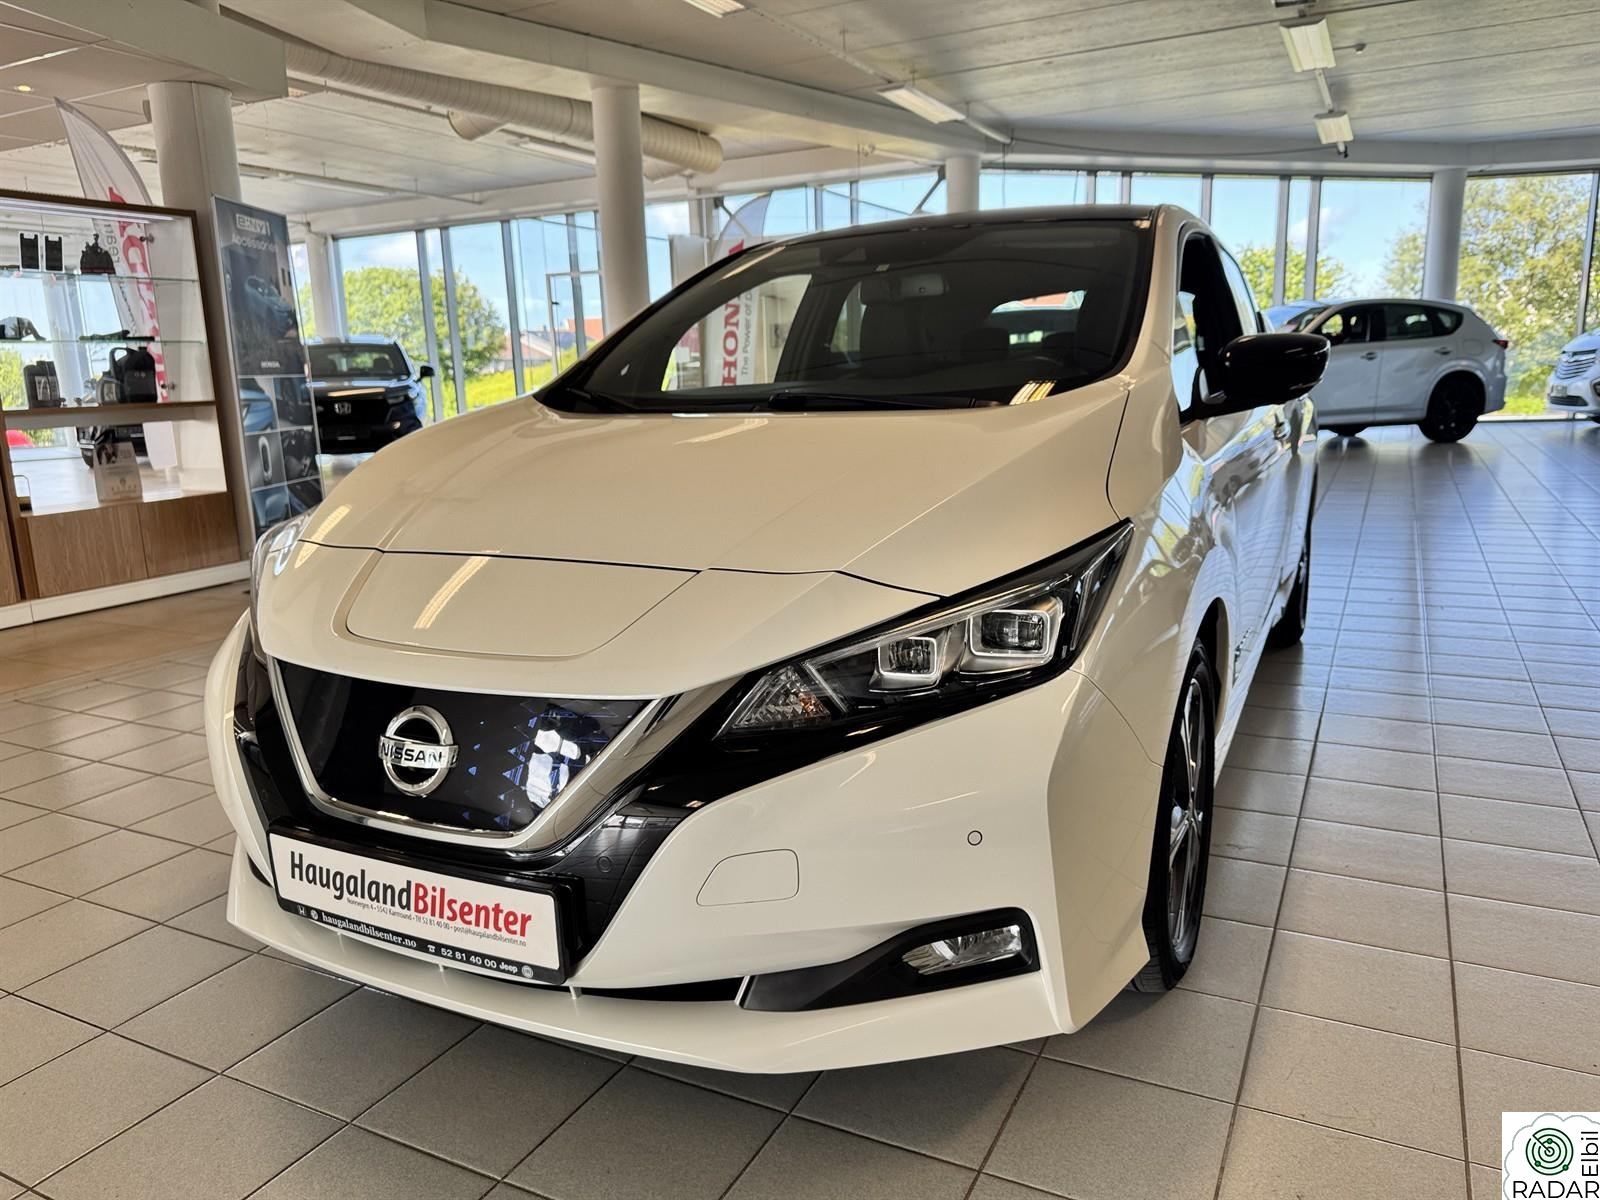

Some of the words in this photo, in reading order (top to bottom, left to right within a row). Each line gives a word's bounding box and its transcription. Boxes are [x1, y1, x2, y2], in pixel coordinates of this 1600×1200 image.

[742, 318, 752, 353] Power
[381, 742, 442, 762] NISSAN
[290, 851, 532, 937] HaugalandBilsenter
[388, 908, 412, 921] Karmsund
[322, 911, 417, 948] haugalandbilsenter.no
[441, 947, 453, 957] 52
[455, 951, 467, 961] 81
[469, 955, 482, 965] 40
[484, 958, 497, 969] 00
[499, 961, 518, 974] Jeep
